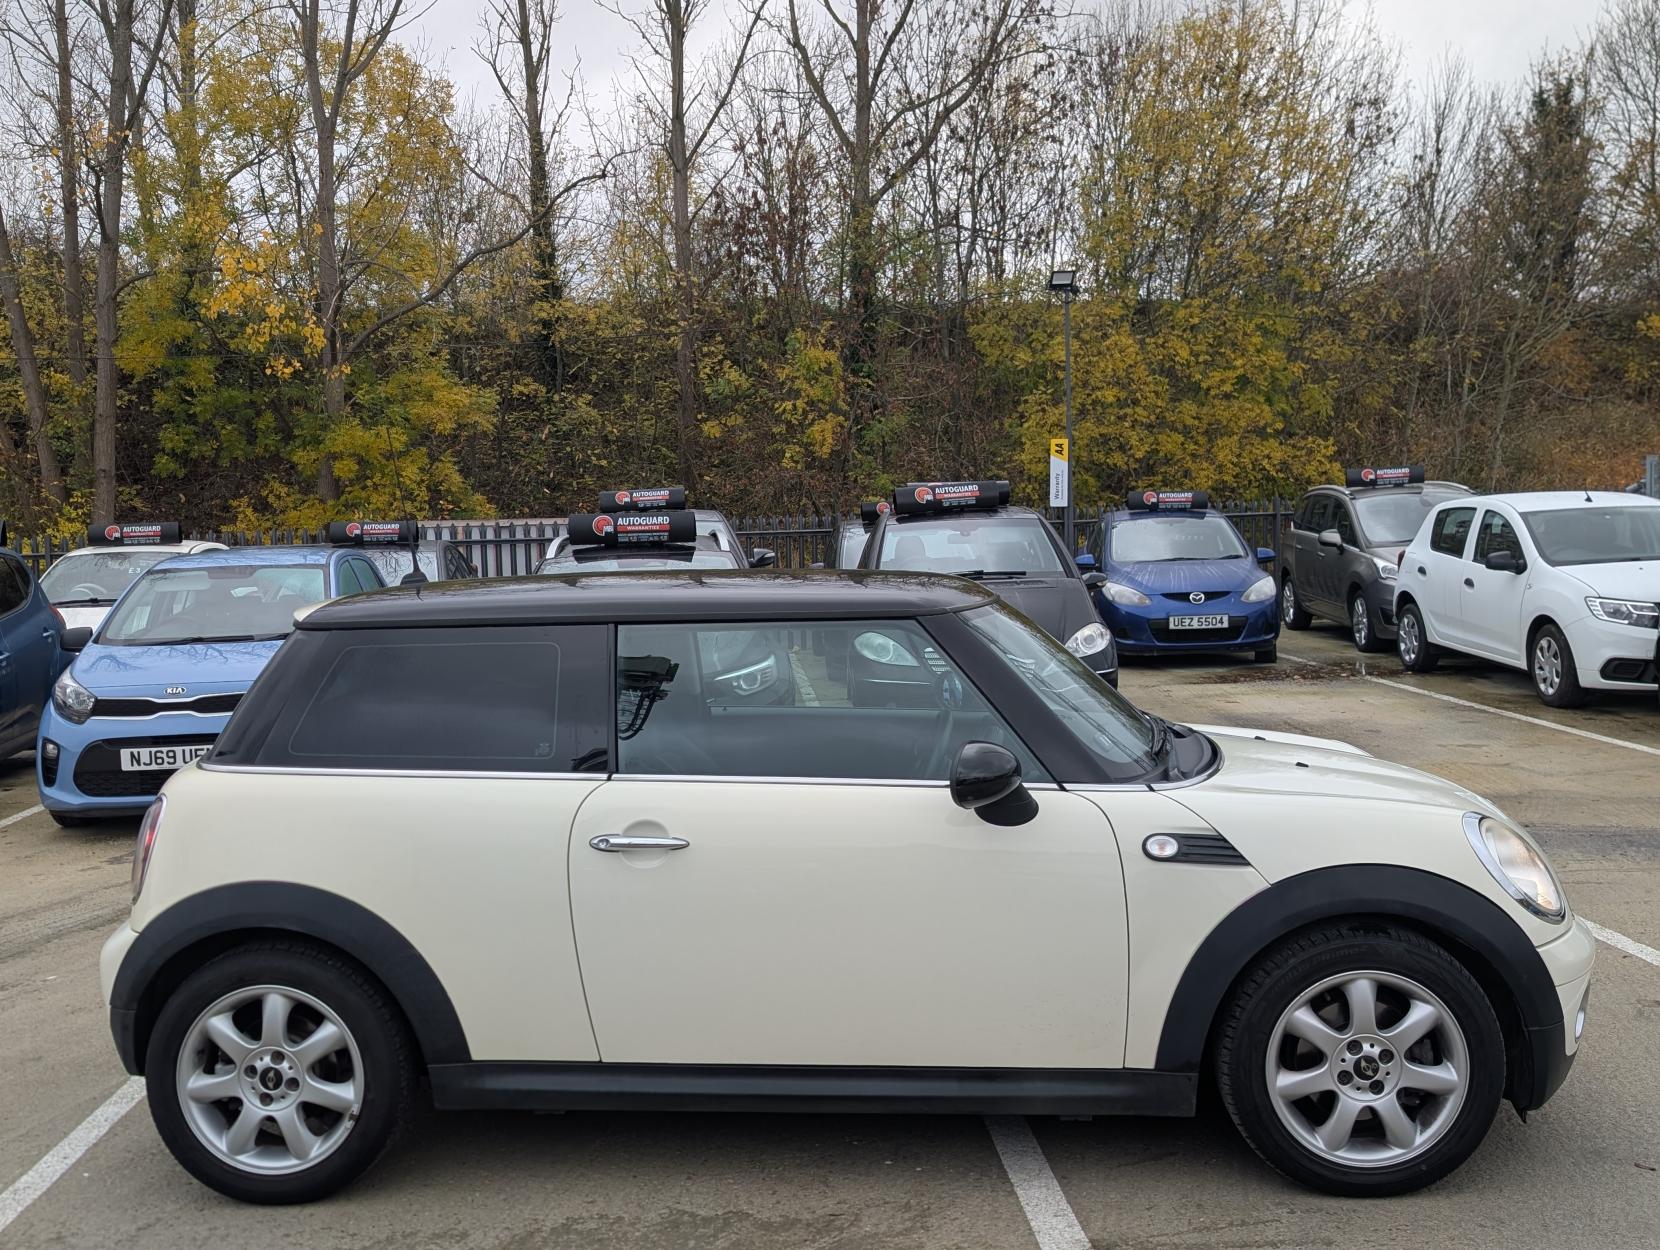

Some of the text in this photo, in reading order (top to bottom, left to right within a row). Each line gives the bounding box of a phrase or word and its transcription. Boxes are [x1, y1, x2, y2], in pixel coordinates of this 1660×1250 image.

[1055, 443, 1065, 456] AA
[935, 484, 978, 494] AUTOGUARD
[617, 516, 670, 526] AUTOGUARD
[1172, 616, 1225, 627] UEZ 5504
[130, 750, 176, 767] NJ69
